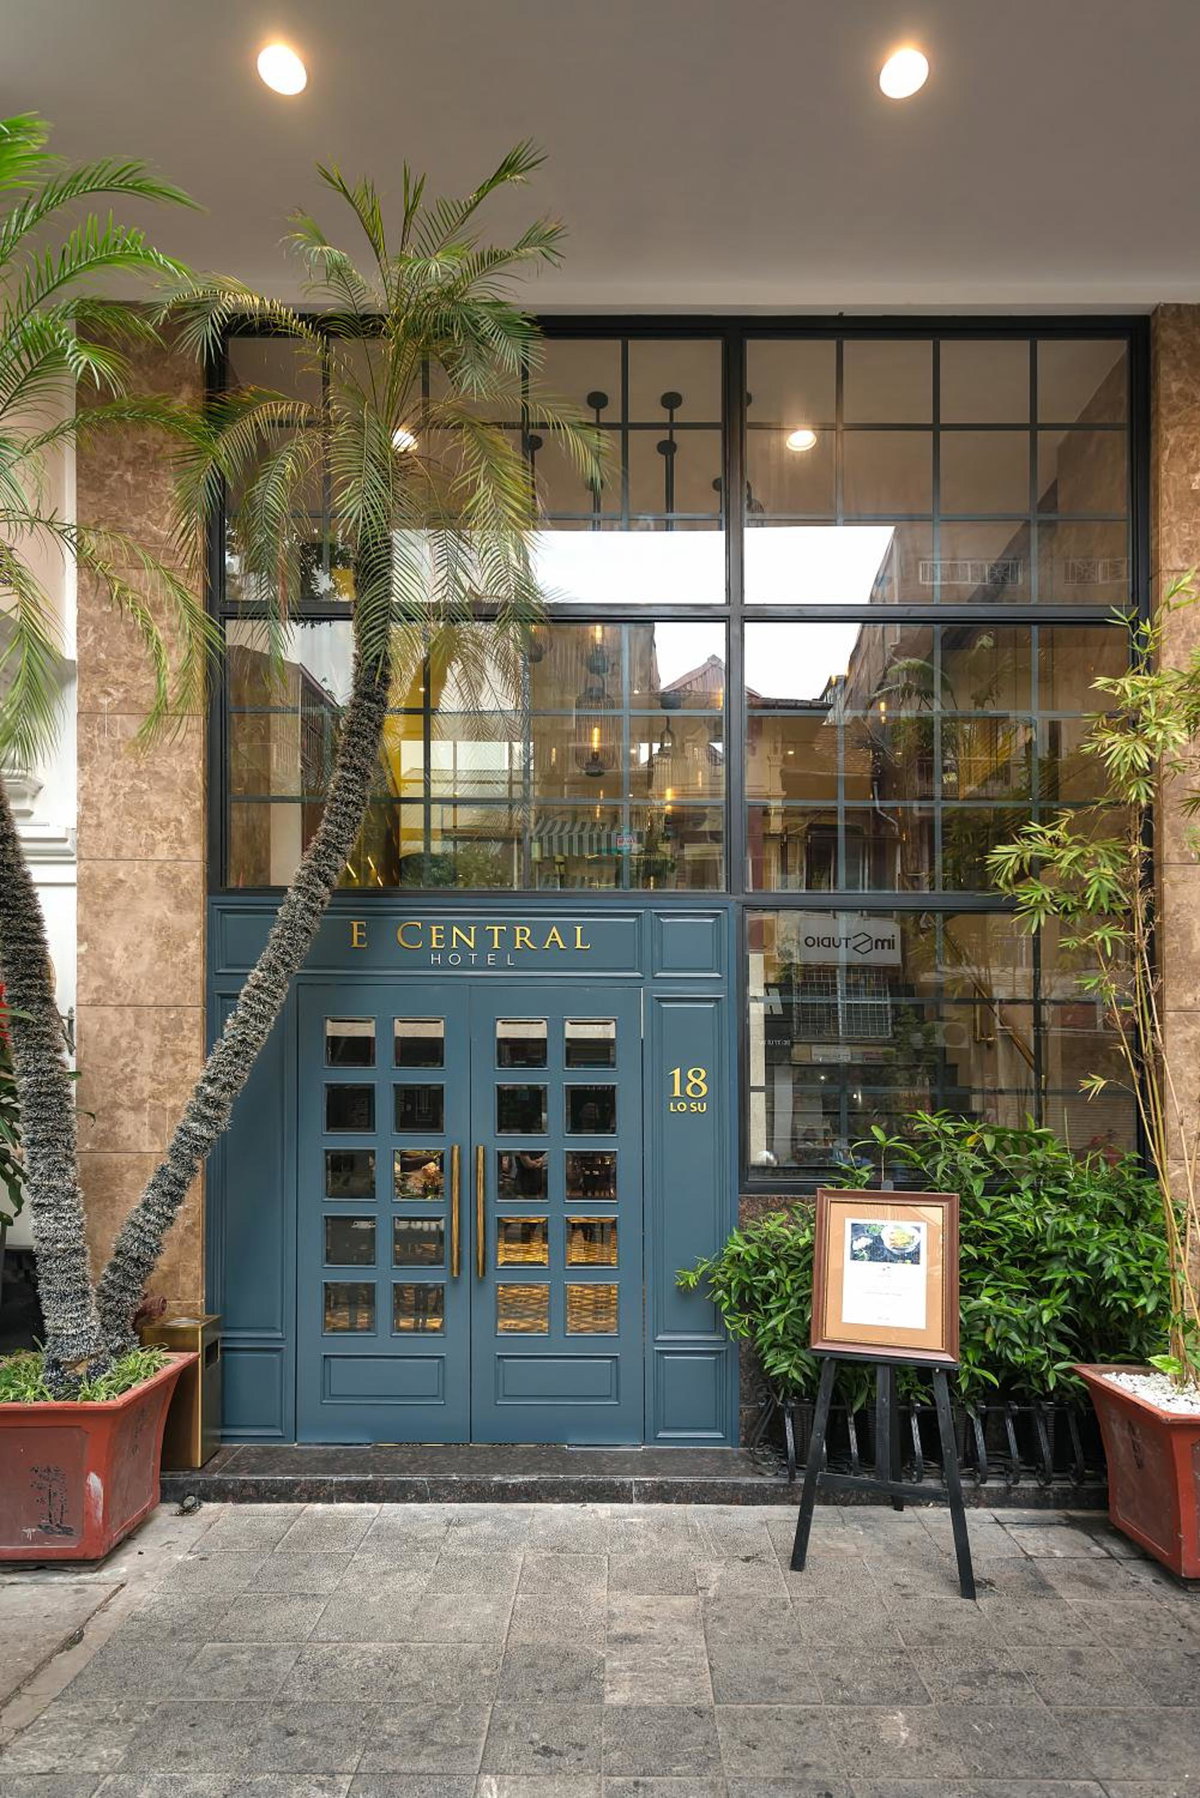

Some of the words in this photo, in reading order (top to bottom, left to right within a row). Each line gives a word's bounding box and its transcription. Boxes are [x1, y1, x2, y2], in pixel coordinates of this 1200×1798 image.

[350, 921, 368, 948] E
[397, 921, 591, 950] CENTRAL
[430, 953, 515, 966] HOTEL
[668, 1067, 708, 1098] 18
[670, 1102, 687, 1112] LO
[690, 1102, 707, 1113] SU
